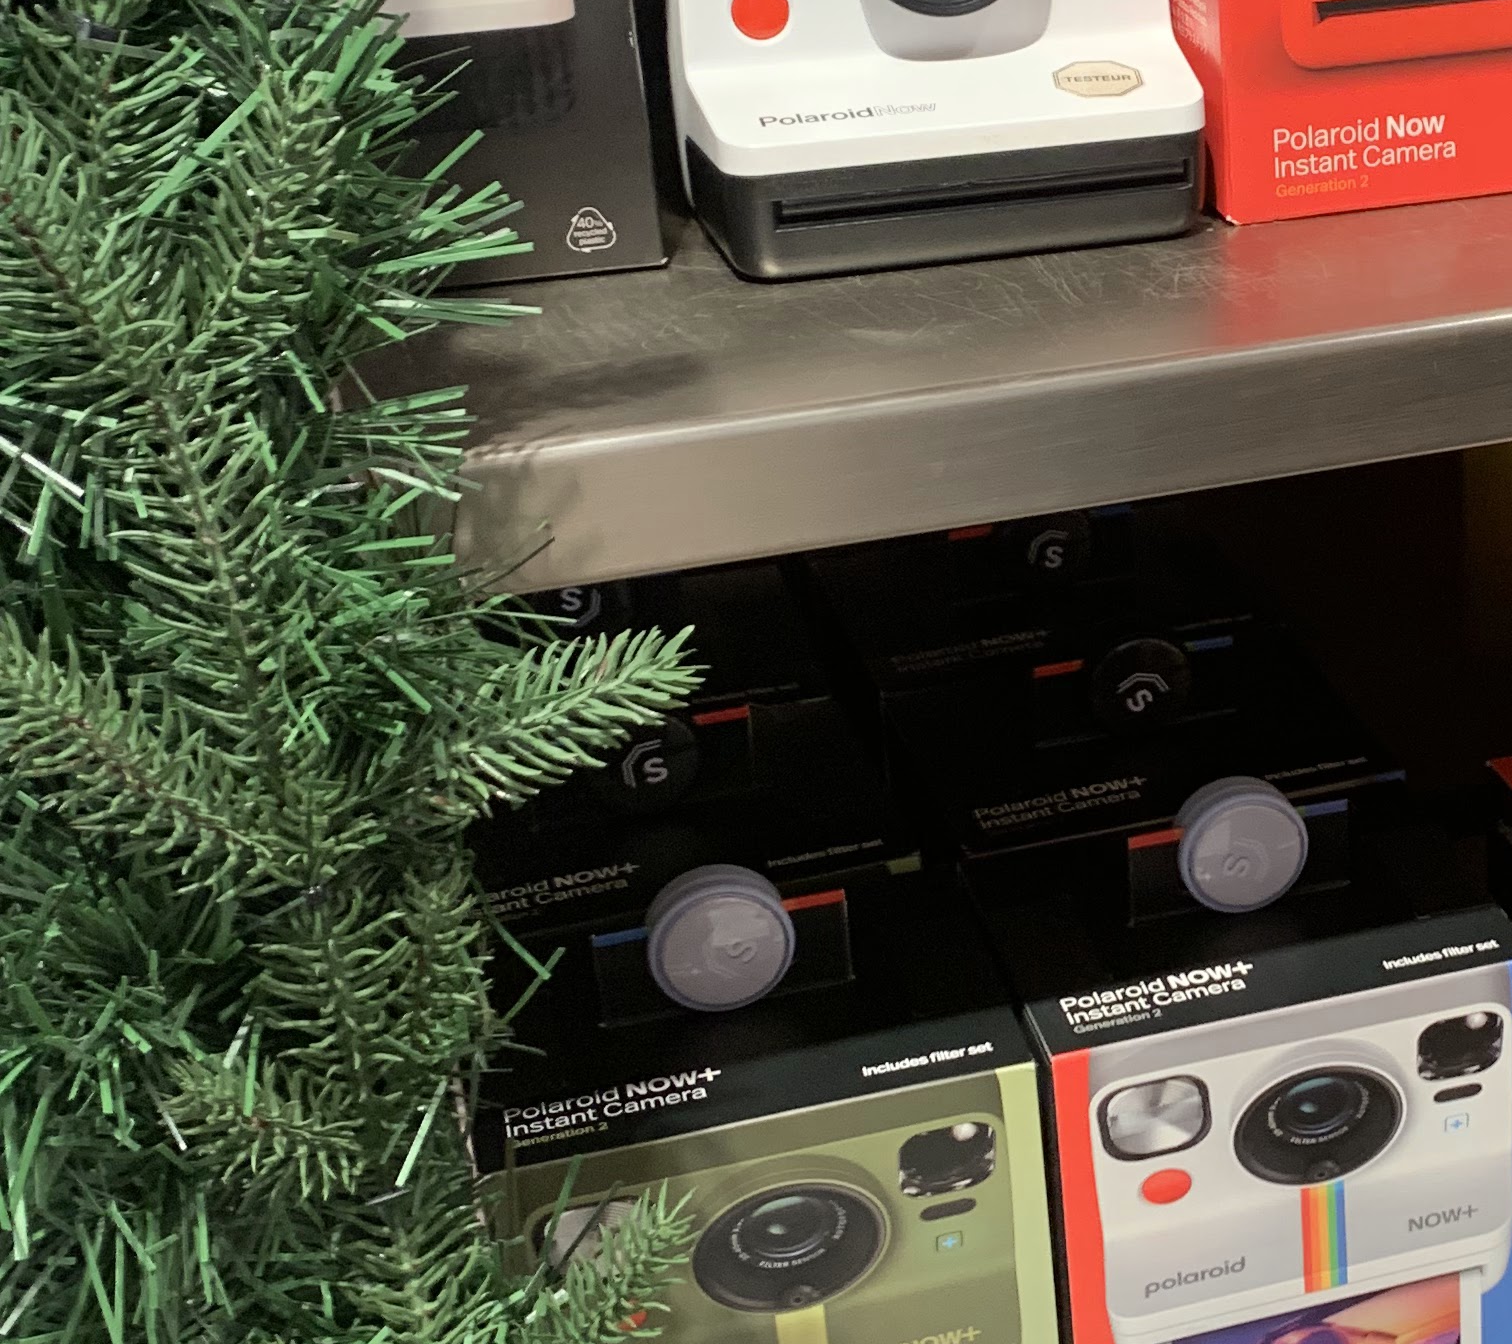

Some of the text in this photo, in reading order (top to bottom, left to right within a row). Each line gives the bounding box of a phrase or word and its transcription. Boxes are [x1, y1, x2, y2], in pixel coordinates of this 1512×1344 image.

[1064, 74, 1132, 83] TESTEUR
[1273, 114, 1446, 153] Polaroid Now
[1274, 140, 1457, 179] Instant Camera
[1275, 174, 1370, 197] Generation 2
[973, 773, 1148, 821] Polaroid NOW+
[979, 790, 1143, 830] Instant Camera
[533, 878, 629, 906] Camera
[554, 862, 640, 888] NOW+
[1382, 939, 1500, 970] Includes filter set
[1059, 960, 1254, 1012] Polaroid NOW+
[1065, 976, 1246, 1027] Instant Camera
[1073, 1007, 1163, 1035] Generation 2
[862, 1041, 994, 1078] Includes filter set
[502, 1066, 722, 1123] Polaroid NOW+
[506, 1085, 708, 1139] Instant Camera
[1407, 1204, 1479, 1233] NOW+
[1143, 1256, 1247, 1298] polaroid
